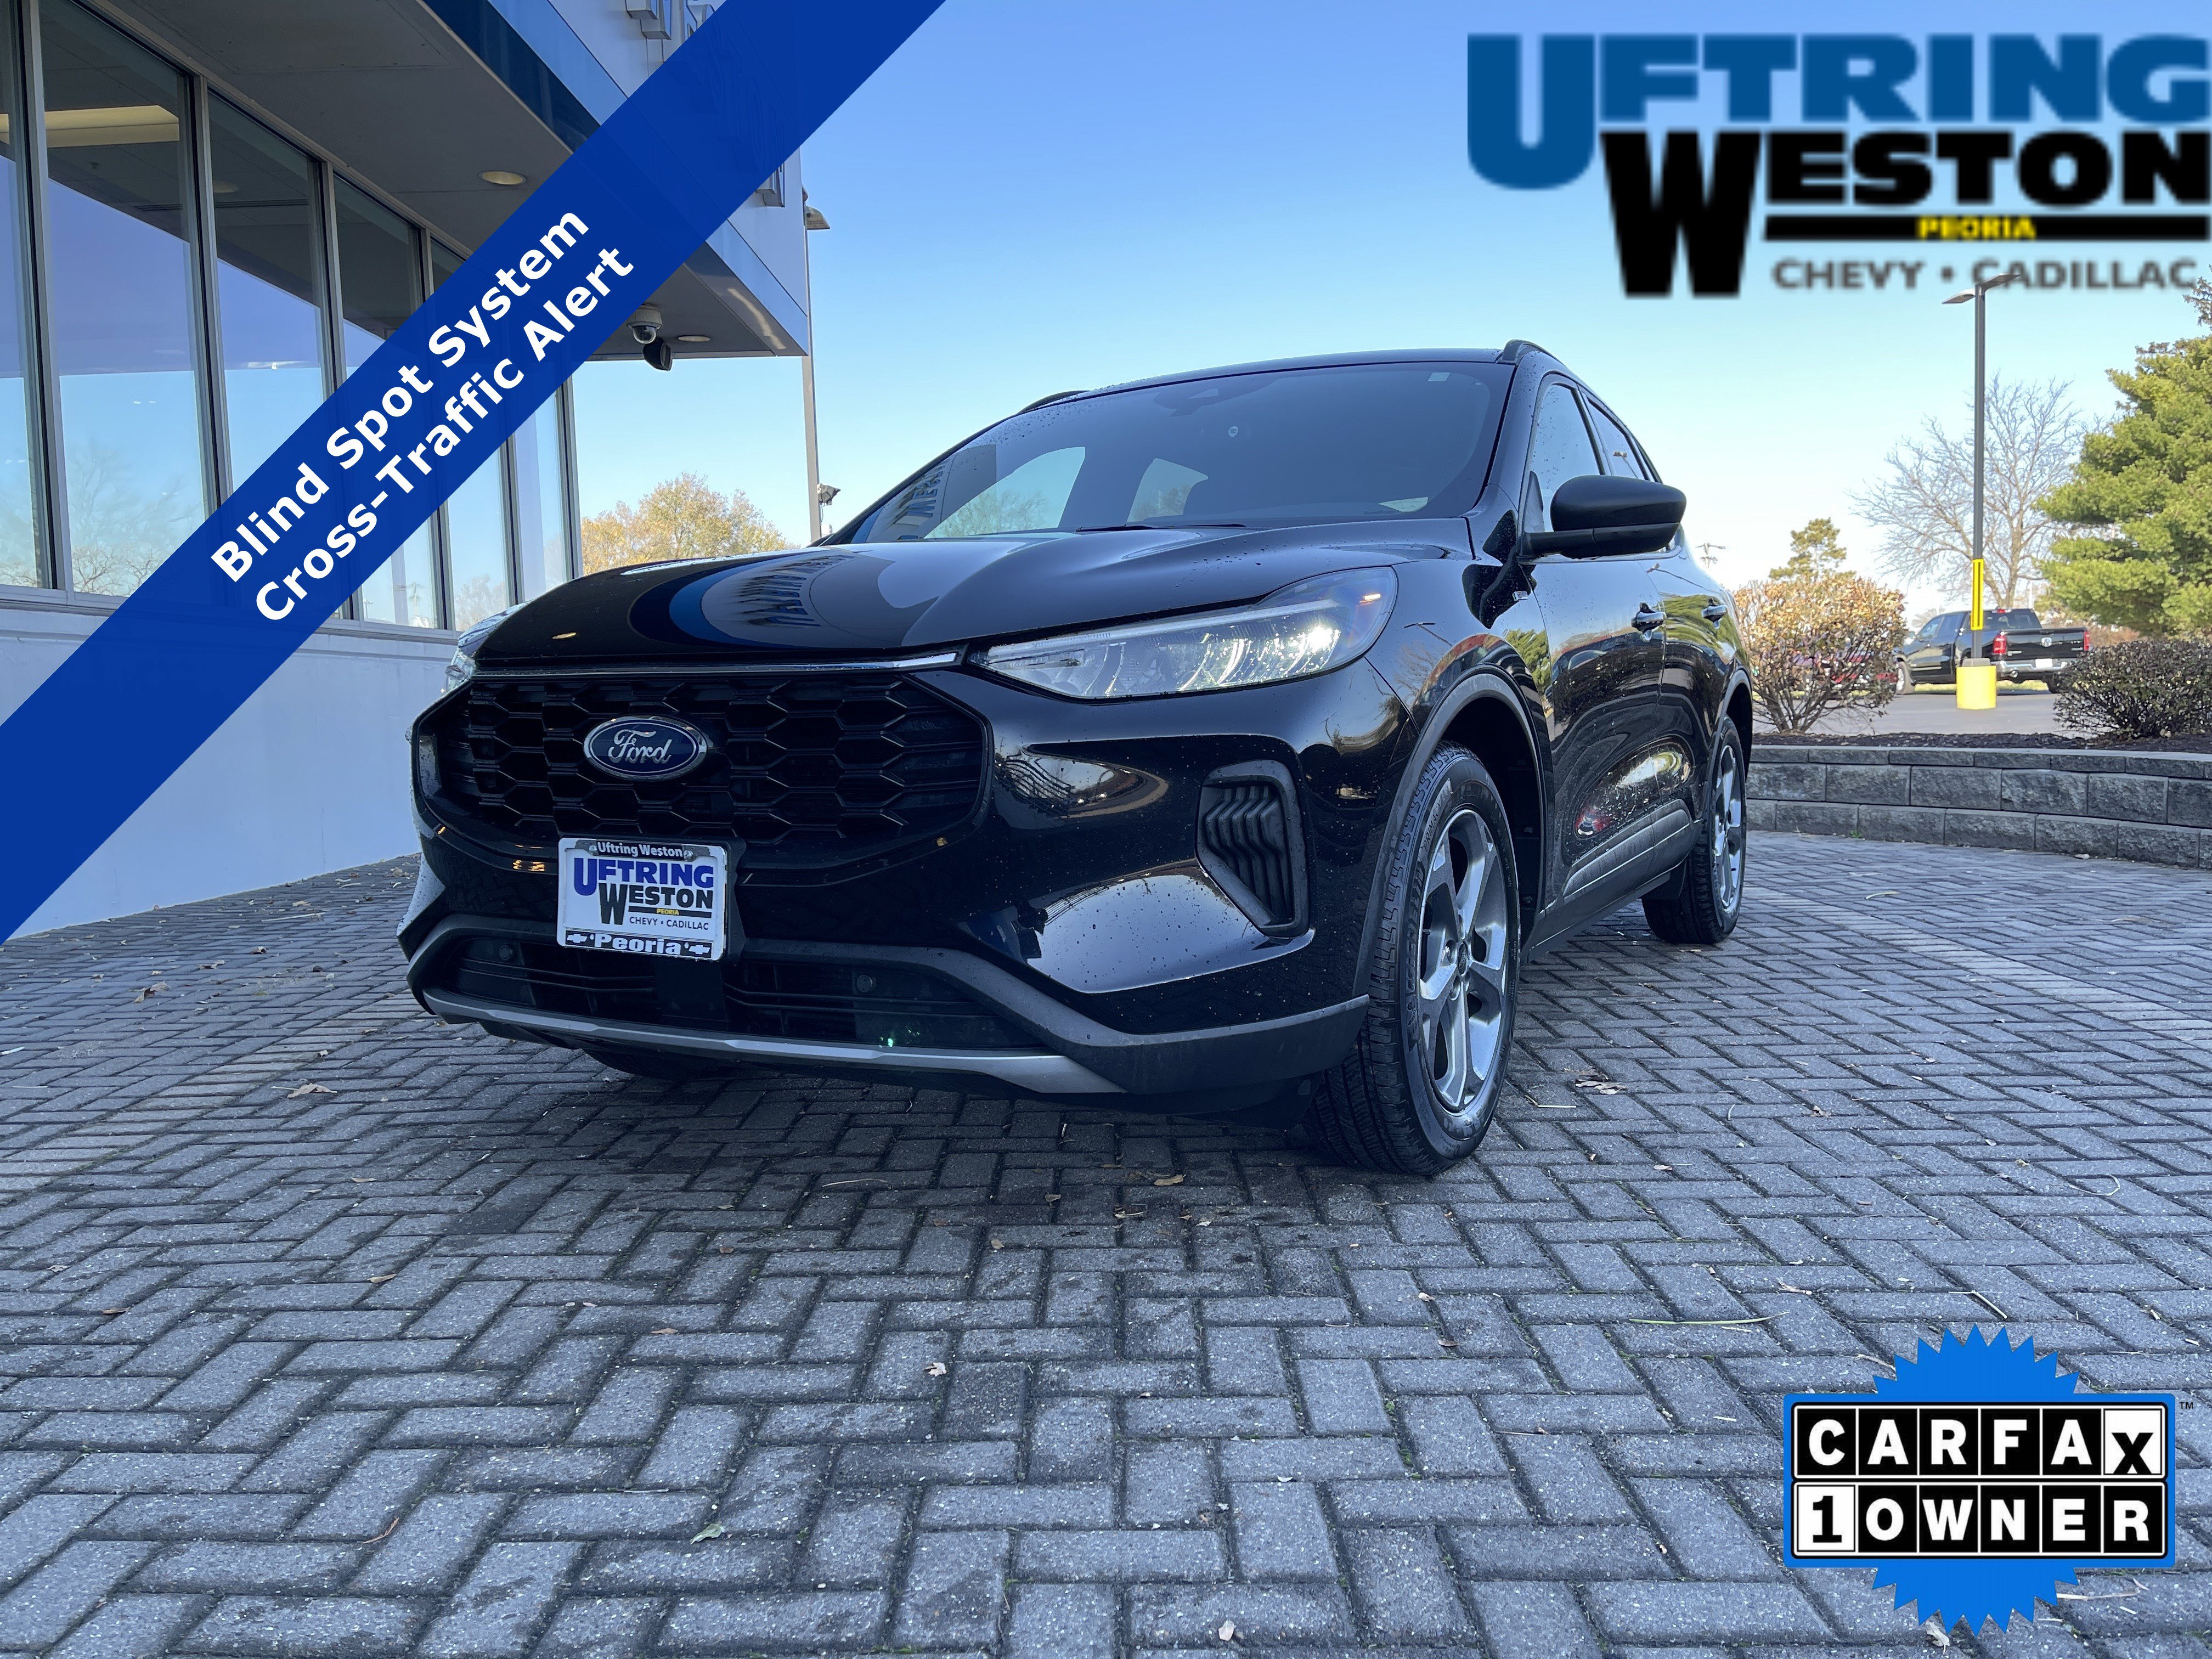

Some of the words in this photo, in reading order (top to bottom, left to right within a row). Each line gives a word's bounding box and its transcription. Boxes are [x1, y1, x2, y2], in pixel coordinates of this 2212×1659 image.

[608, 729, 673, 764] Ford
[597, 842, 638, 857] Uftring
[639, 844, 683, 858] Weston
[574, 857, 714, 896] UFTRING
[599, 882, 714, 926] WESTON
[629, 917, 658, 926] CHEVY
[666, 919, 709, 930] CADILLAC
[594, 933, 681, 955] Peoria
